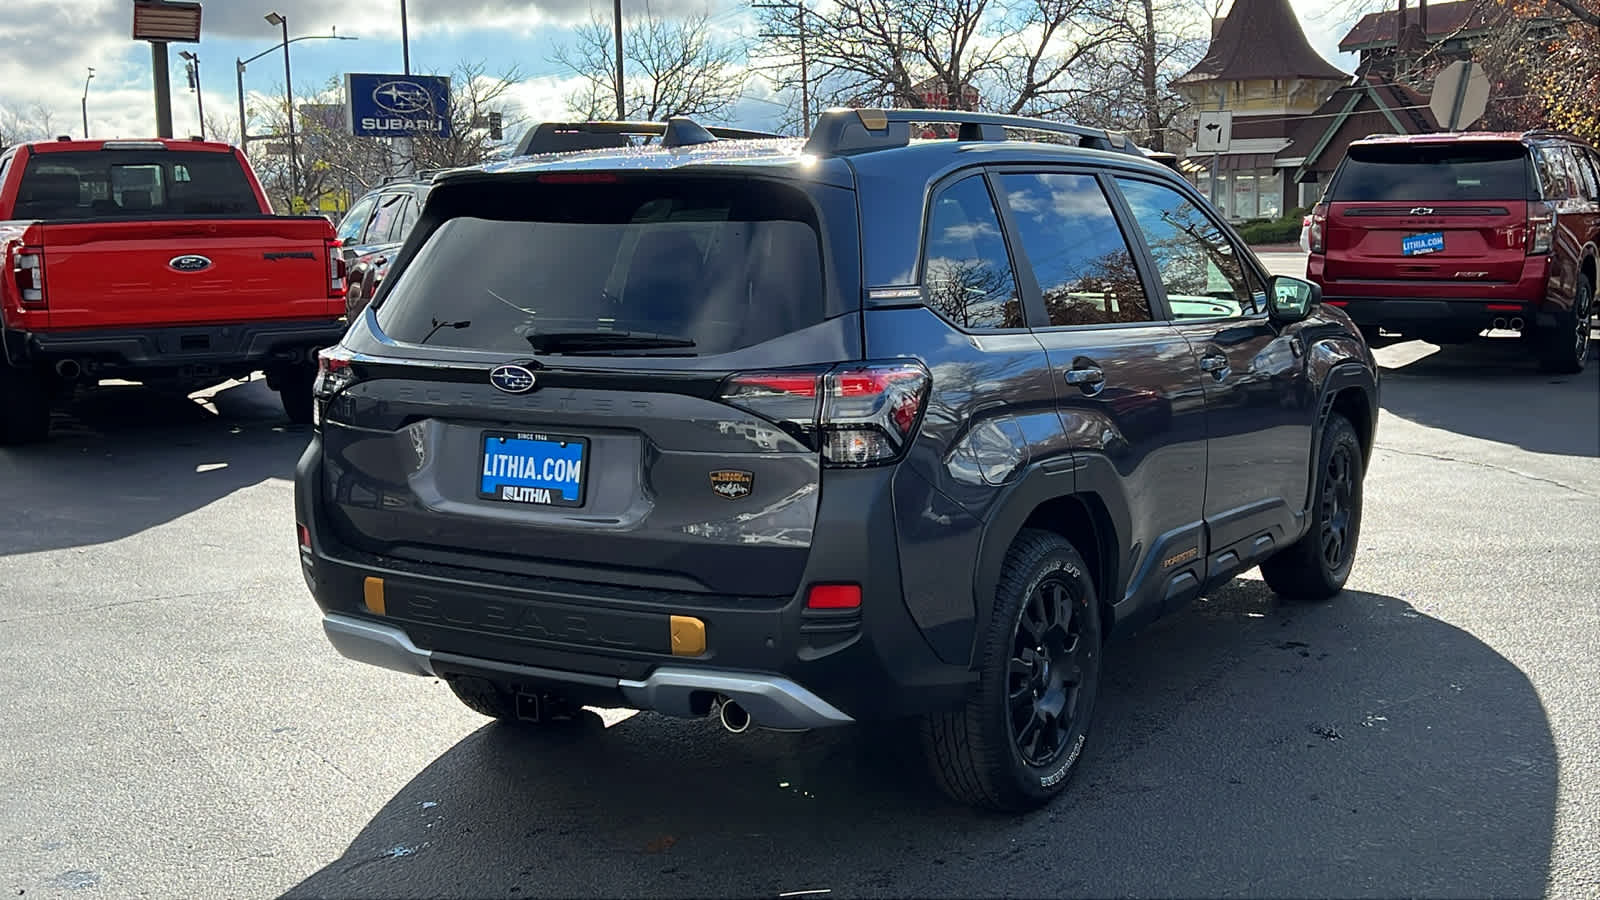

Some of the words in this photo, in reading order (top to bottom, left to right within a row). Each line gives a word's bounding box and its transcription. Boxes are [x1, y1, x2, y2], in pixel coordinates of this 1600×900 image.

[1403, 237, 1443, 251] LITHIA.COM
[517, 432, 533, 440] SINCE
[483, 453, 581, 484] LITHIA.COM
[514, 486, 551, 504] LITHIA
